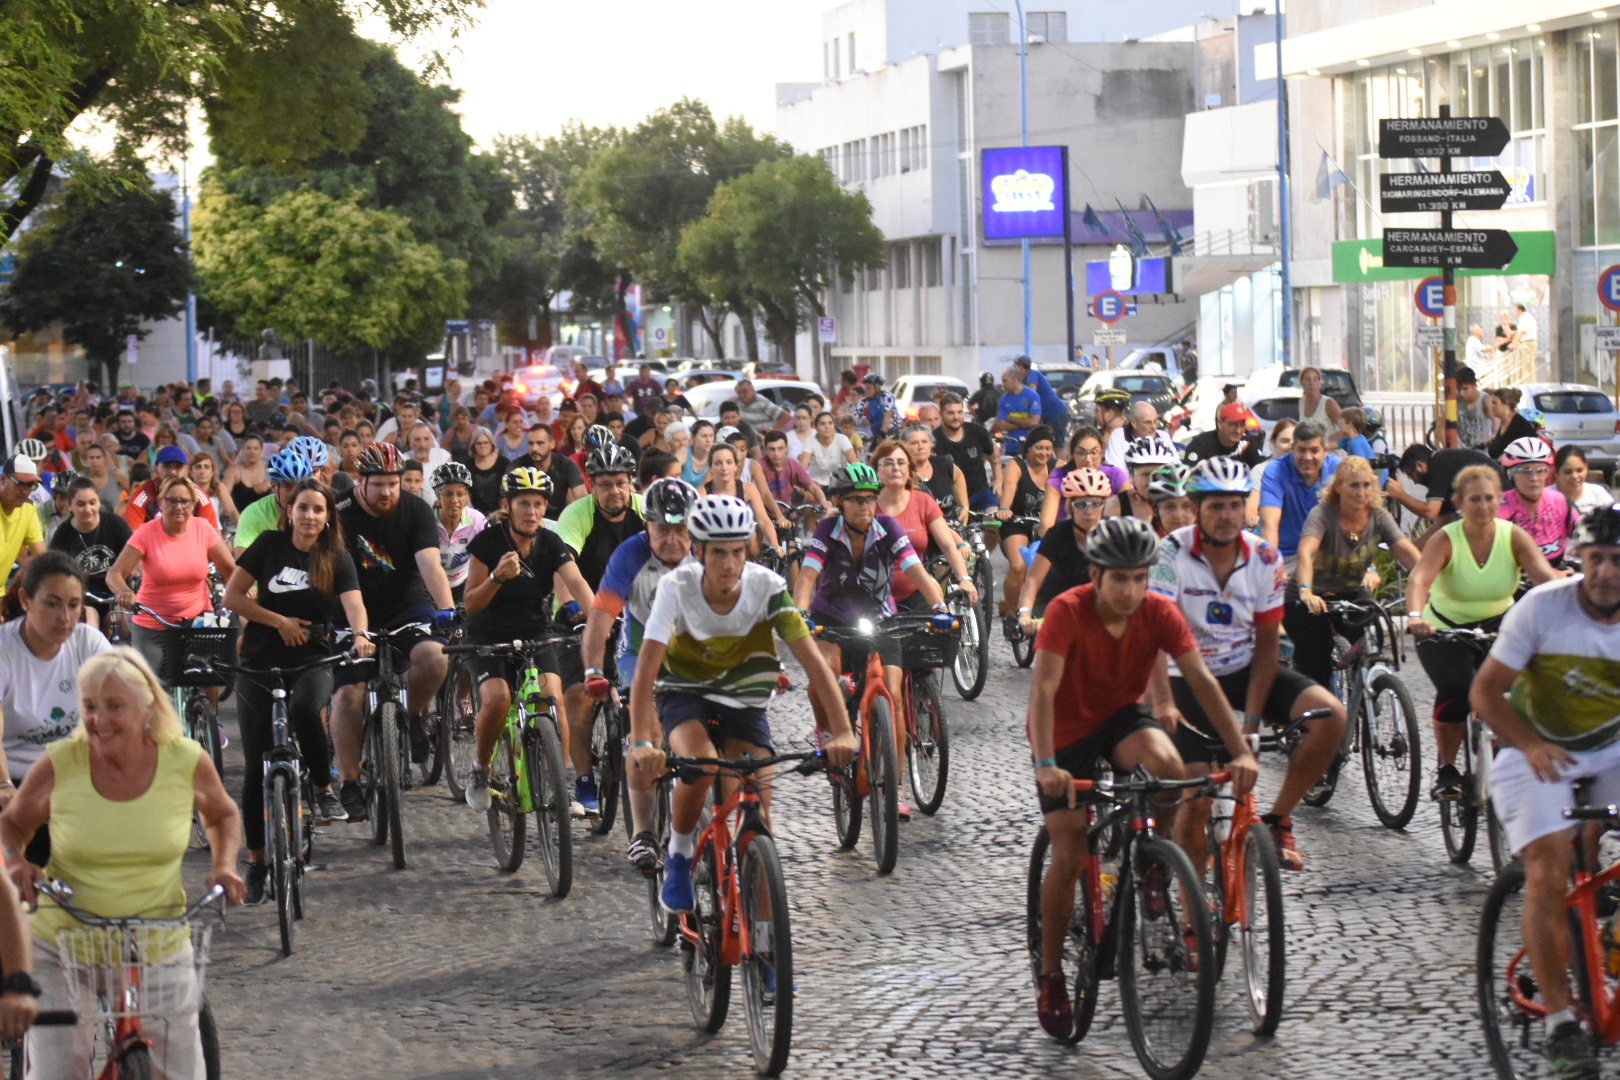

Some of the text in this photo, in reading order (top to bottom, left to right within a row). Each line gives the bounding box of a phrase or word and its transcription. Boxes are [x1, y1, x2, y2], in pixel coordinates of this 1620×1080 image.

[1386, 119, 1488, 131] HERMANAMIENTO
[1399, 135, 1476, 143] FOSSANO-ITALIA
[1448, 147, 1461, 155] KM
[1389, 173, 1492, 186] HERMANAMIENTO
[1381, 187, 1505, 199] SIGMARINGENDORF-ALEMANIA
[1452, 201, 1467, 210] KM
[1387, 231, 1488, 243] HERMANAMIENTO
[1390, 243, 1485, 253] CARCABUEY-ESPAÑA
[1447, 256, 1462, 264] KM
[1427, 285, 1444, 308] E
[1102, 297, 1117, 315] E
